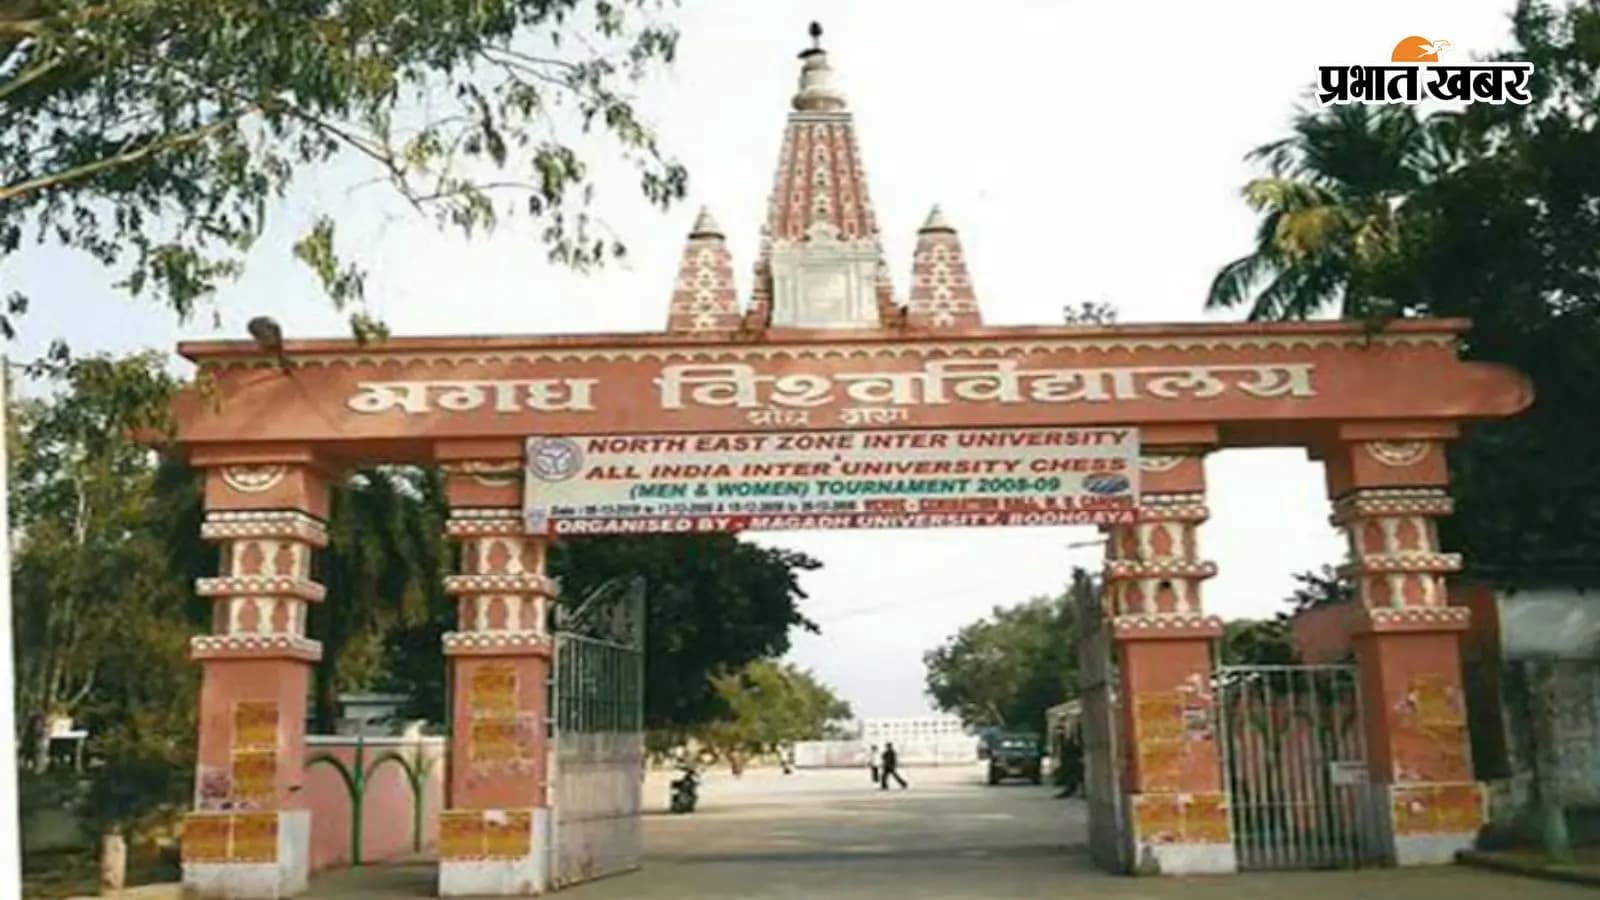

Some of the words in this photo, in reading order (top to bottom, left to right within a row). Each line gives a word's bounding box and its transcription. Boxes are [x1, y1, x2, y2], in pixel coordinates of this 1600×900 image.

[348, 377, 600, 414] मगध
[652, 358, 1317, 411] विश्वविद्यालय
[587, 437, 684, 454] NORTH
[695, 435, 772, 452] EAST
[776, 434, 853, 450] ZONE
[862, 433, 949, 449] INTER
[957, 430, 1129, 447] UNIVERSITY
[585, 464, 642, 480] ALL
[650, 463, 731, 479] INDIA
[741, 461, 832, 477] INTER
[840, 458, 1021, 476] UNIVERSITY
[1028, 456, 1128, 474] CHESS
[630, 481, 688, 499] (MEN
[694, 482, 708, 497] &
[717, 480, 809, 498] WOMEN)
[816, 478, 970, 495] TOURNAMENT
[555, 518, 692, 534] ORGANISED
[697, 517, 728, 532] BY
[750, 514, 852, 530] MAGADH
